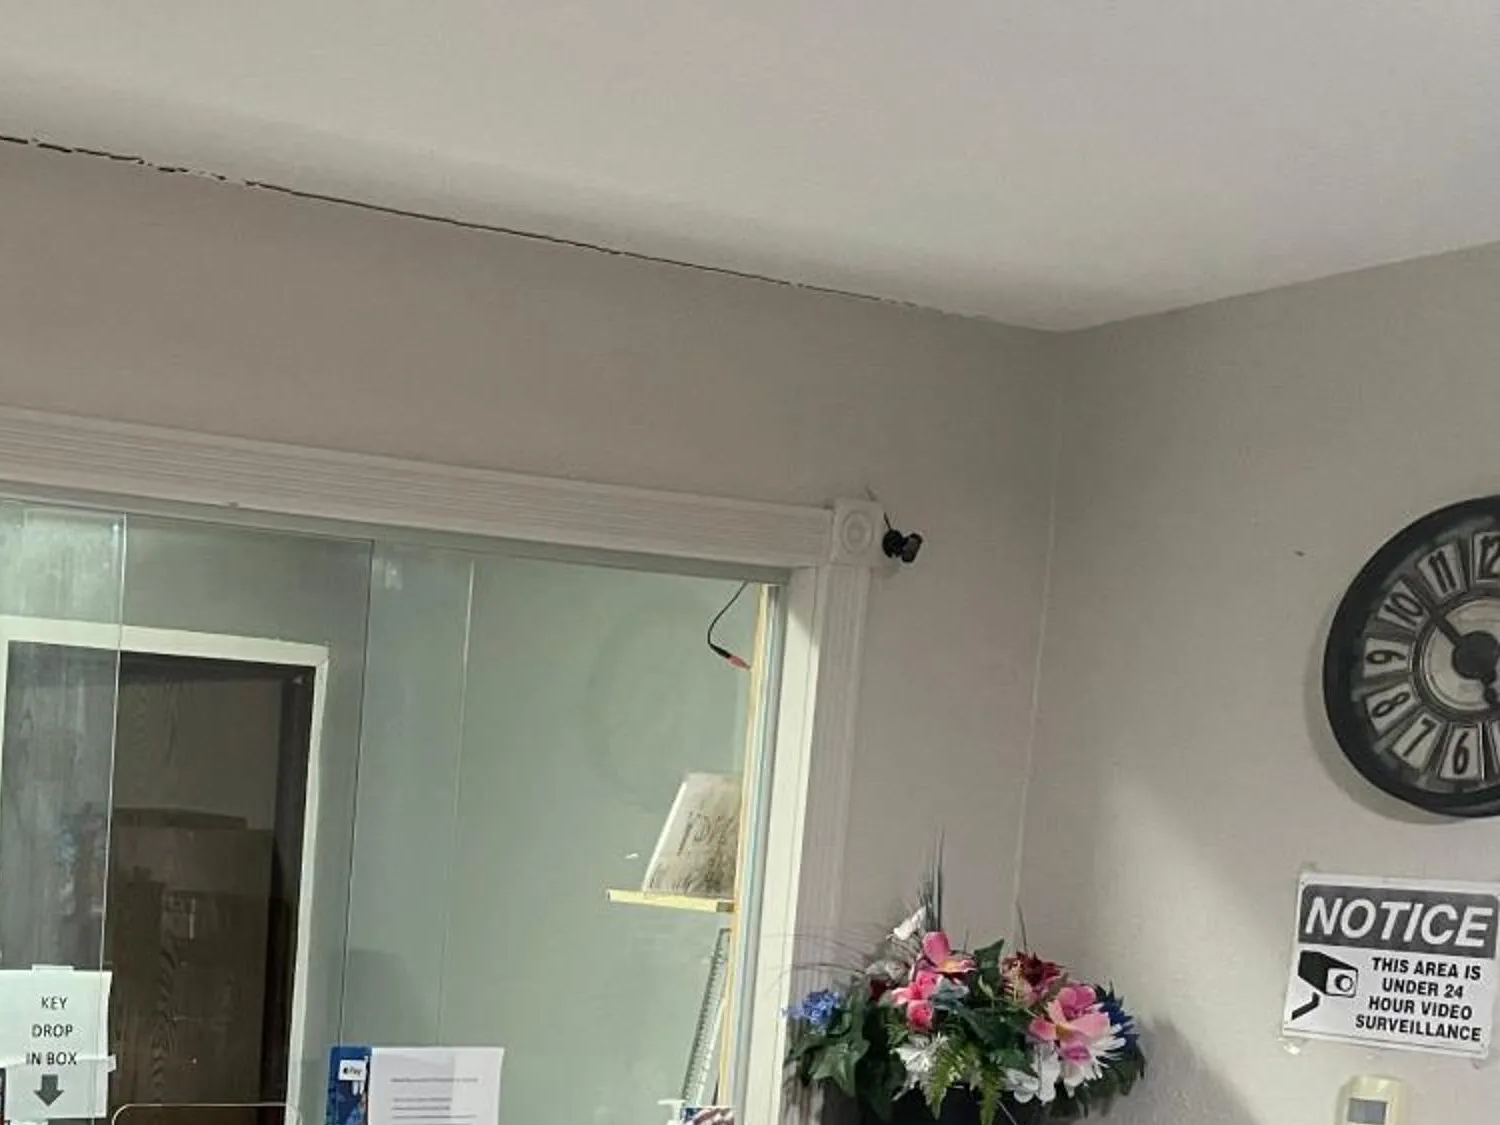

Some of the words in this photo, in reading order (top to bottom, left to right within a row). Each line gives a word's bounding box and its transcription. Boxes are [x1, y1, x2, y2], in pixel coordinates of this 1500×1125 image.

[1427, 549, 1457, 593] 11
[1384, 592, 1425, 627] 10
[1364, 649, 1406, 666] 9
[1371, 691, 1411, 718] 8
[1402, 716, 1438, 758] 7
[1452, 731, 1470, 776] 6
[1304, 896, 1494, 947] NOTICE
[1372, 957, 1409, 974] THIS
[1413, 961, 1459, 978] AREA
[1464, 965, 1482, 980] IS
[1382, 978, 1439, 996] UNDER
[1443, 984, 1464, 999] 24
[41, 996, 68, 1010] KEY
[1368, 996, 1415, 1014] HOUR
[1421, 1002, 1472, 1020] VIDEO
[31, 1023, 73, 1038] DROP
[1355, 1014, 1482, 1042] SURVEILLANCE
[25, 1052, 42, 1065] IN
[46, 1052, 77, 1065] BOX
